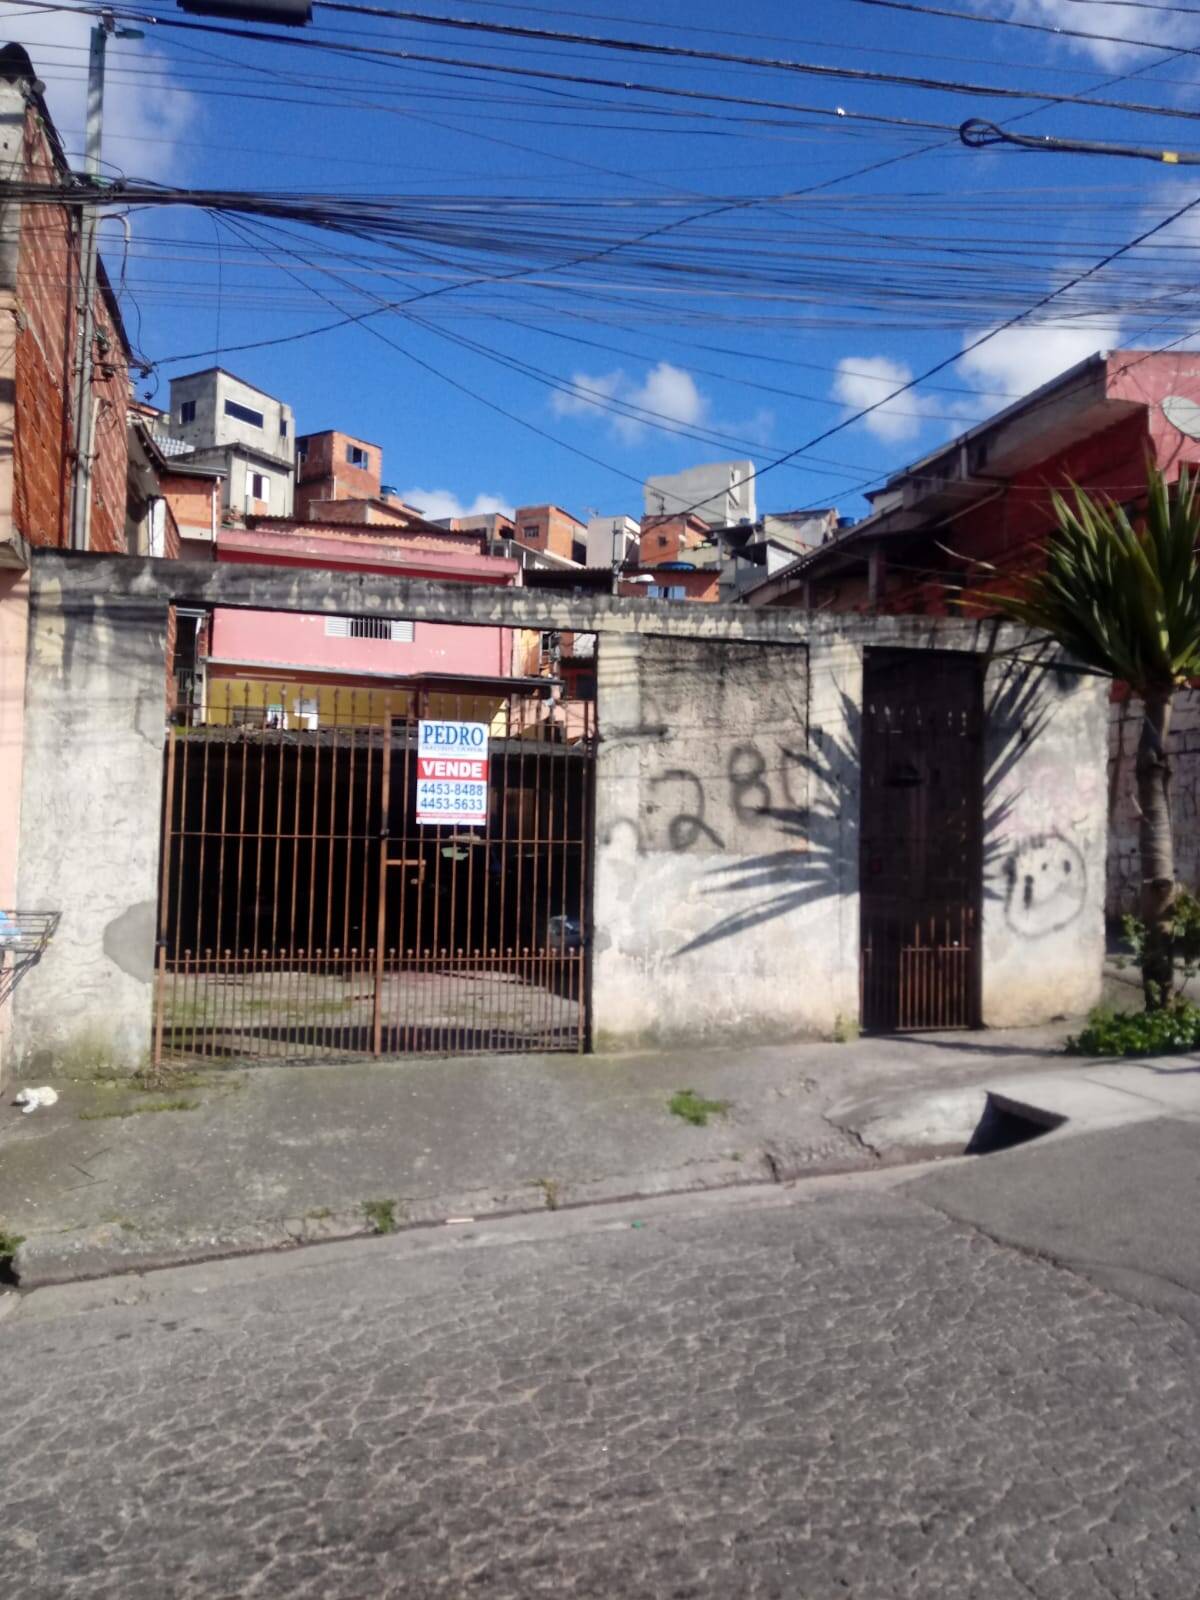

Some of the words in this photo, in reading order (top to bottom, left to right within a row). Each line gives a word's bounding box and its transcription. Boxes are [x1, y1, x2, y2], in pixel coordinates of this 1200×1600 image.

[423, 725, 484, 746] PEDRO
[422, 760, 482, 778] VENDE
[420, 783, 483, 796] 4453-8488
[420, 798, 483, 810] 4453-5633
